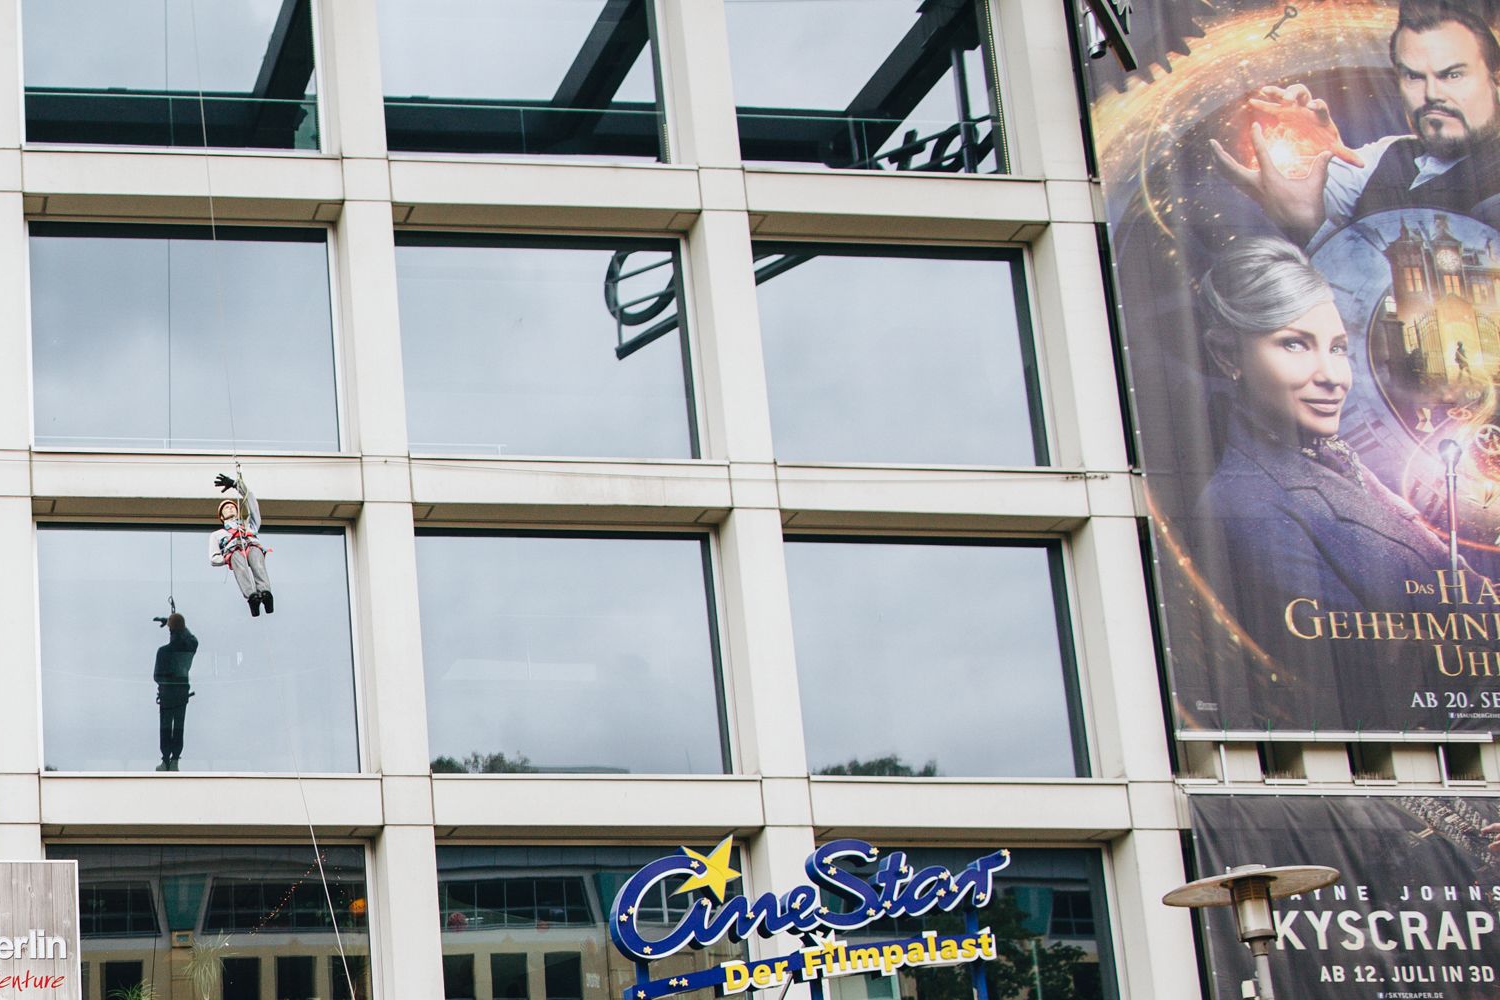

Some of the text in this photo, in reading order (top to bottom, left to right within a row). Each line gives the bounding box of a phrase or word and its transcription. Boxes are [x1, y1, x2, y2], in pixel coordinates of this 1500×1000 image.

[1432, 644, 1500, 677] UH
[1410, 692, 1439, 708] AB
[1444, 692, 1474, 709] 20.
[609, 838, 1011, 961] CineStar
[1272, 910, 1500, 951] KYSCRAP
[722, 929, 996, 994] Der Filmpalast
[1320, 965, 1495, 982] AB 12. JULI IN 3D
